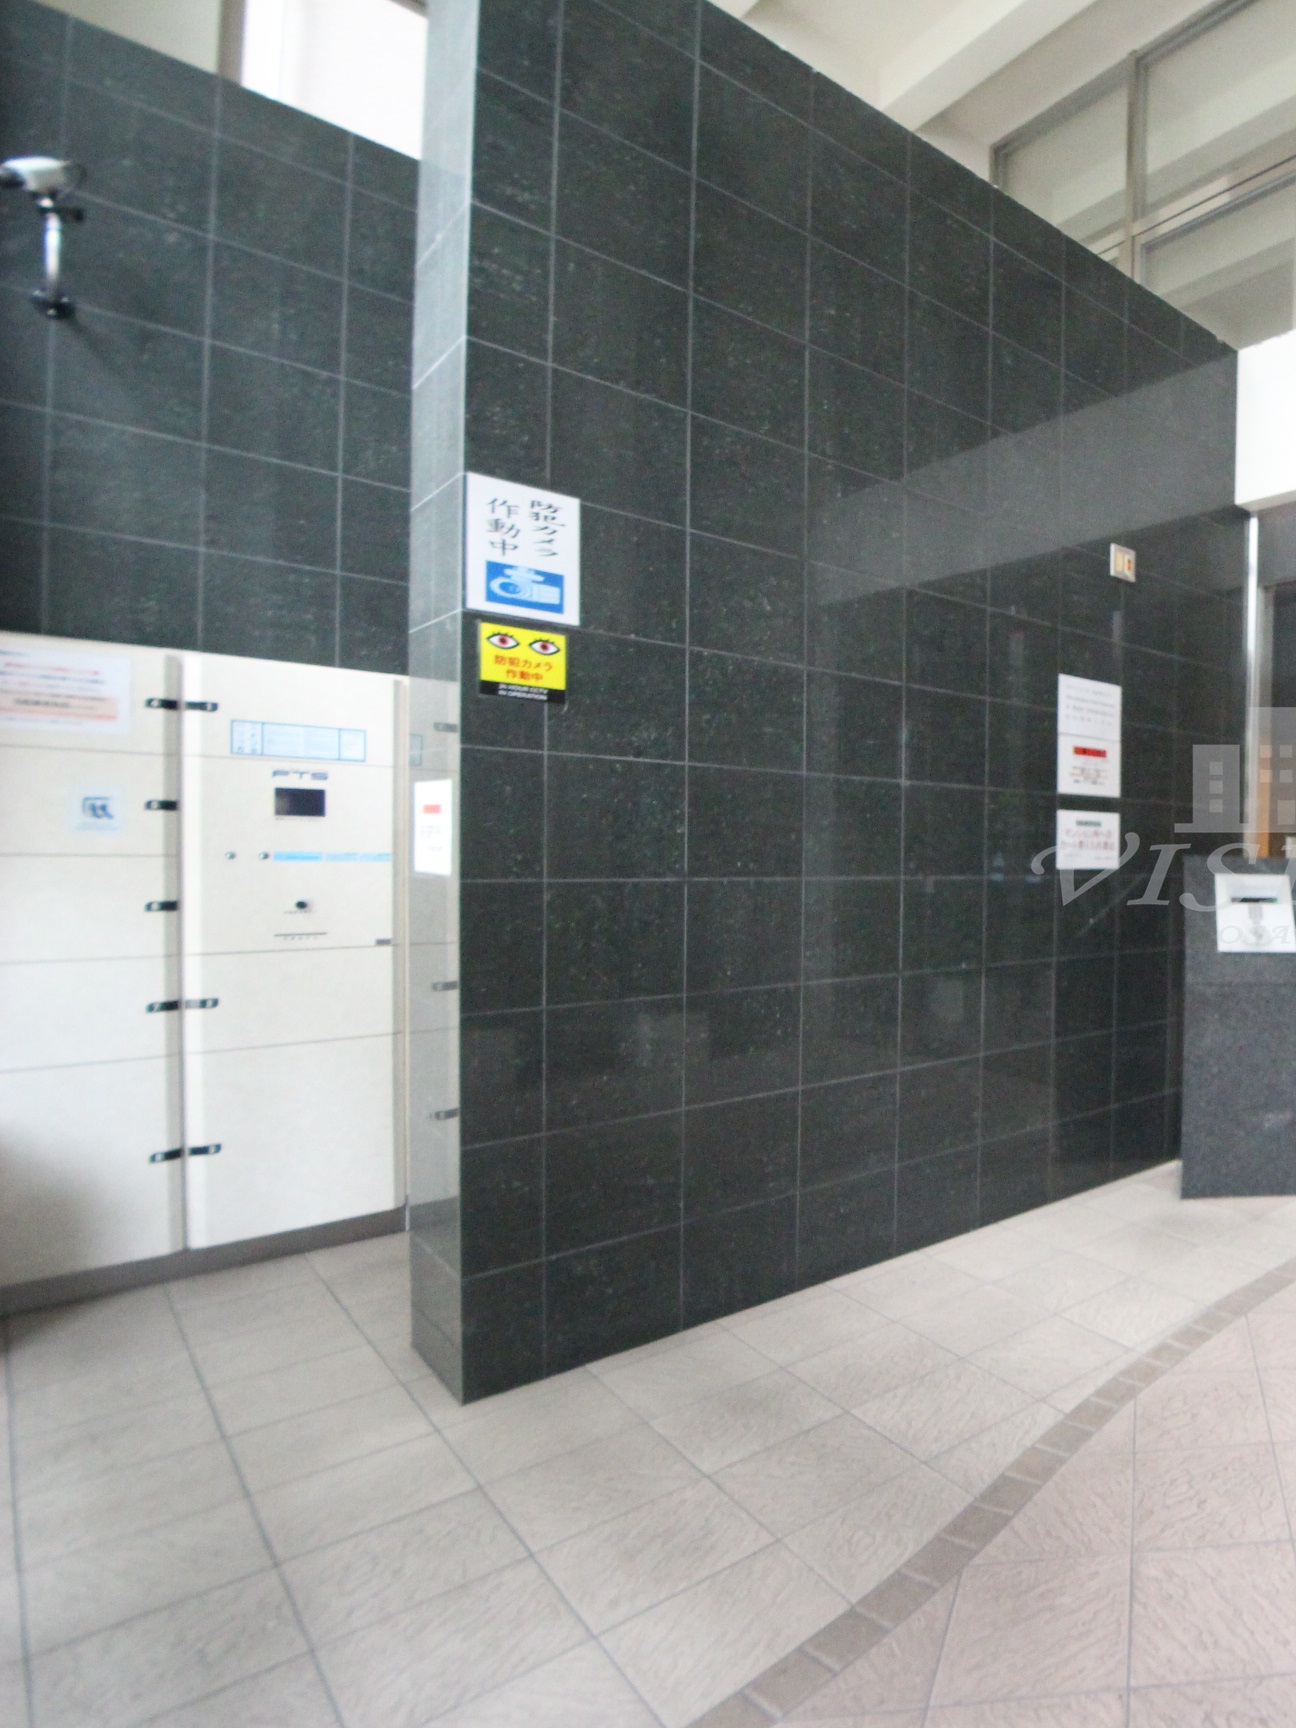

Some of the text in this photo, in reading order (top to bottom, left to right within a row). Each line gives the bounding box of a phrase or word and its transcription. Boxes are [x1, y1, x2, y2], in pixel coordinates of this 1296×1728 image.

[486, 498, 520, 557] 作動中
[529, 500, 566, 557] 防犯カメラ
[494, 654, 554, 672] 防犯カメラ
[505, 669, 544, 681] 作動中
